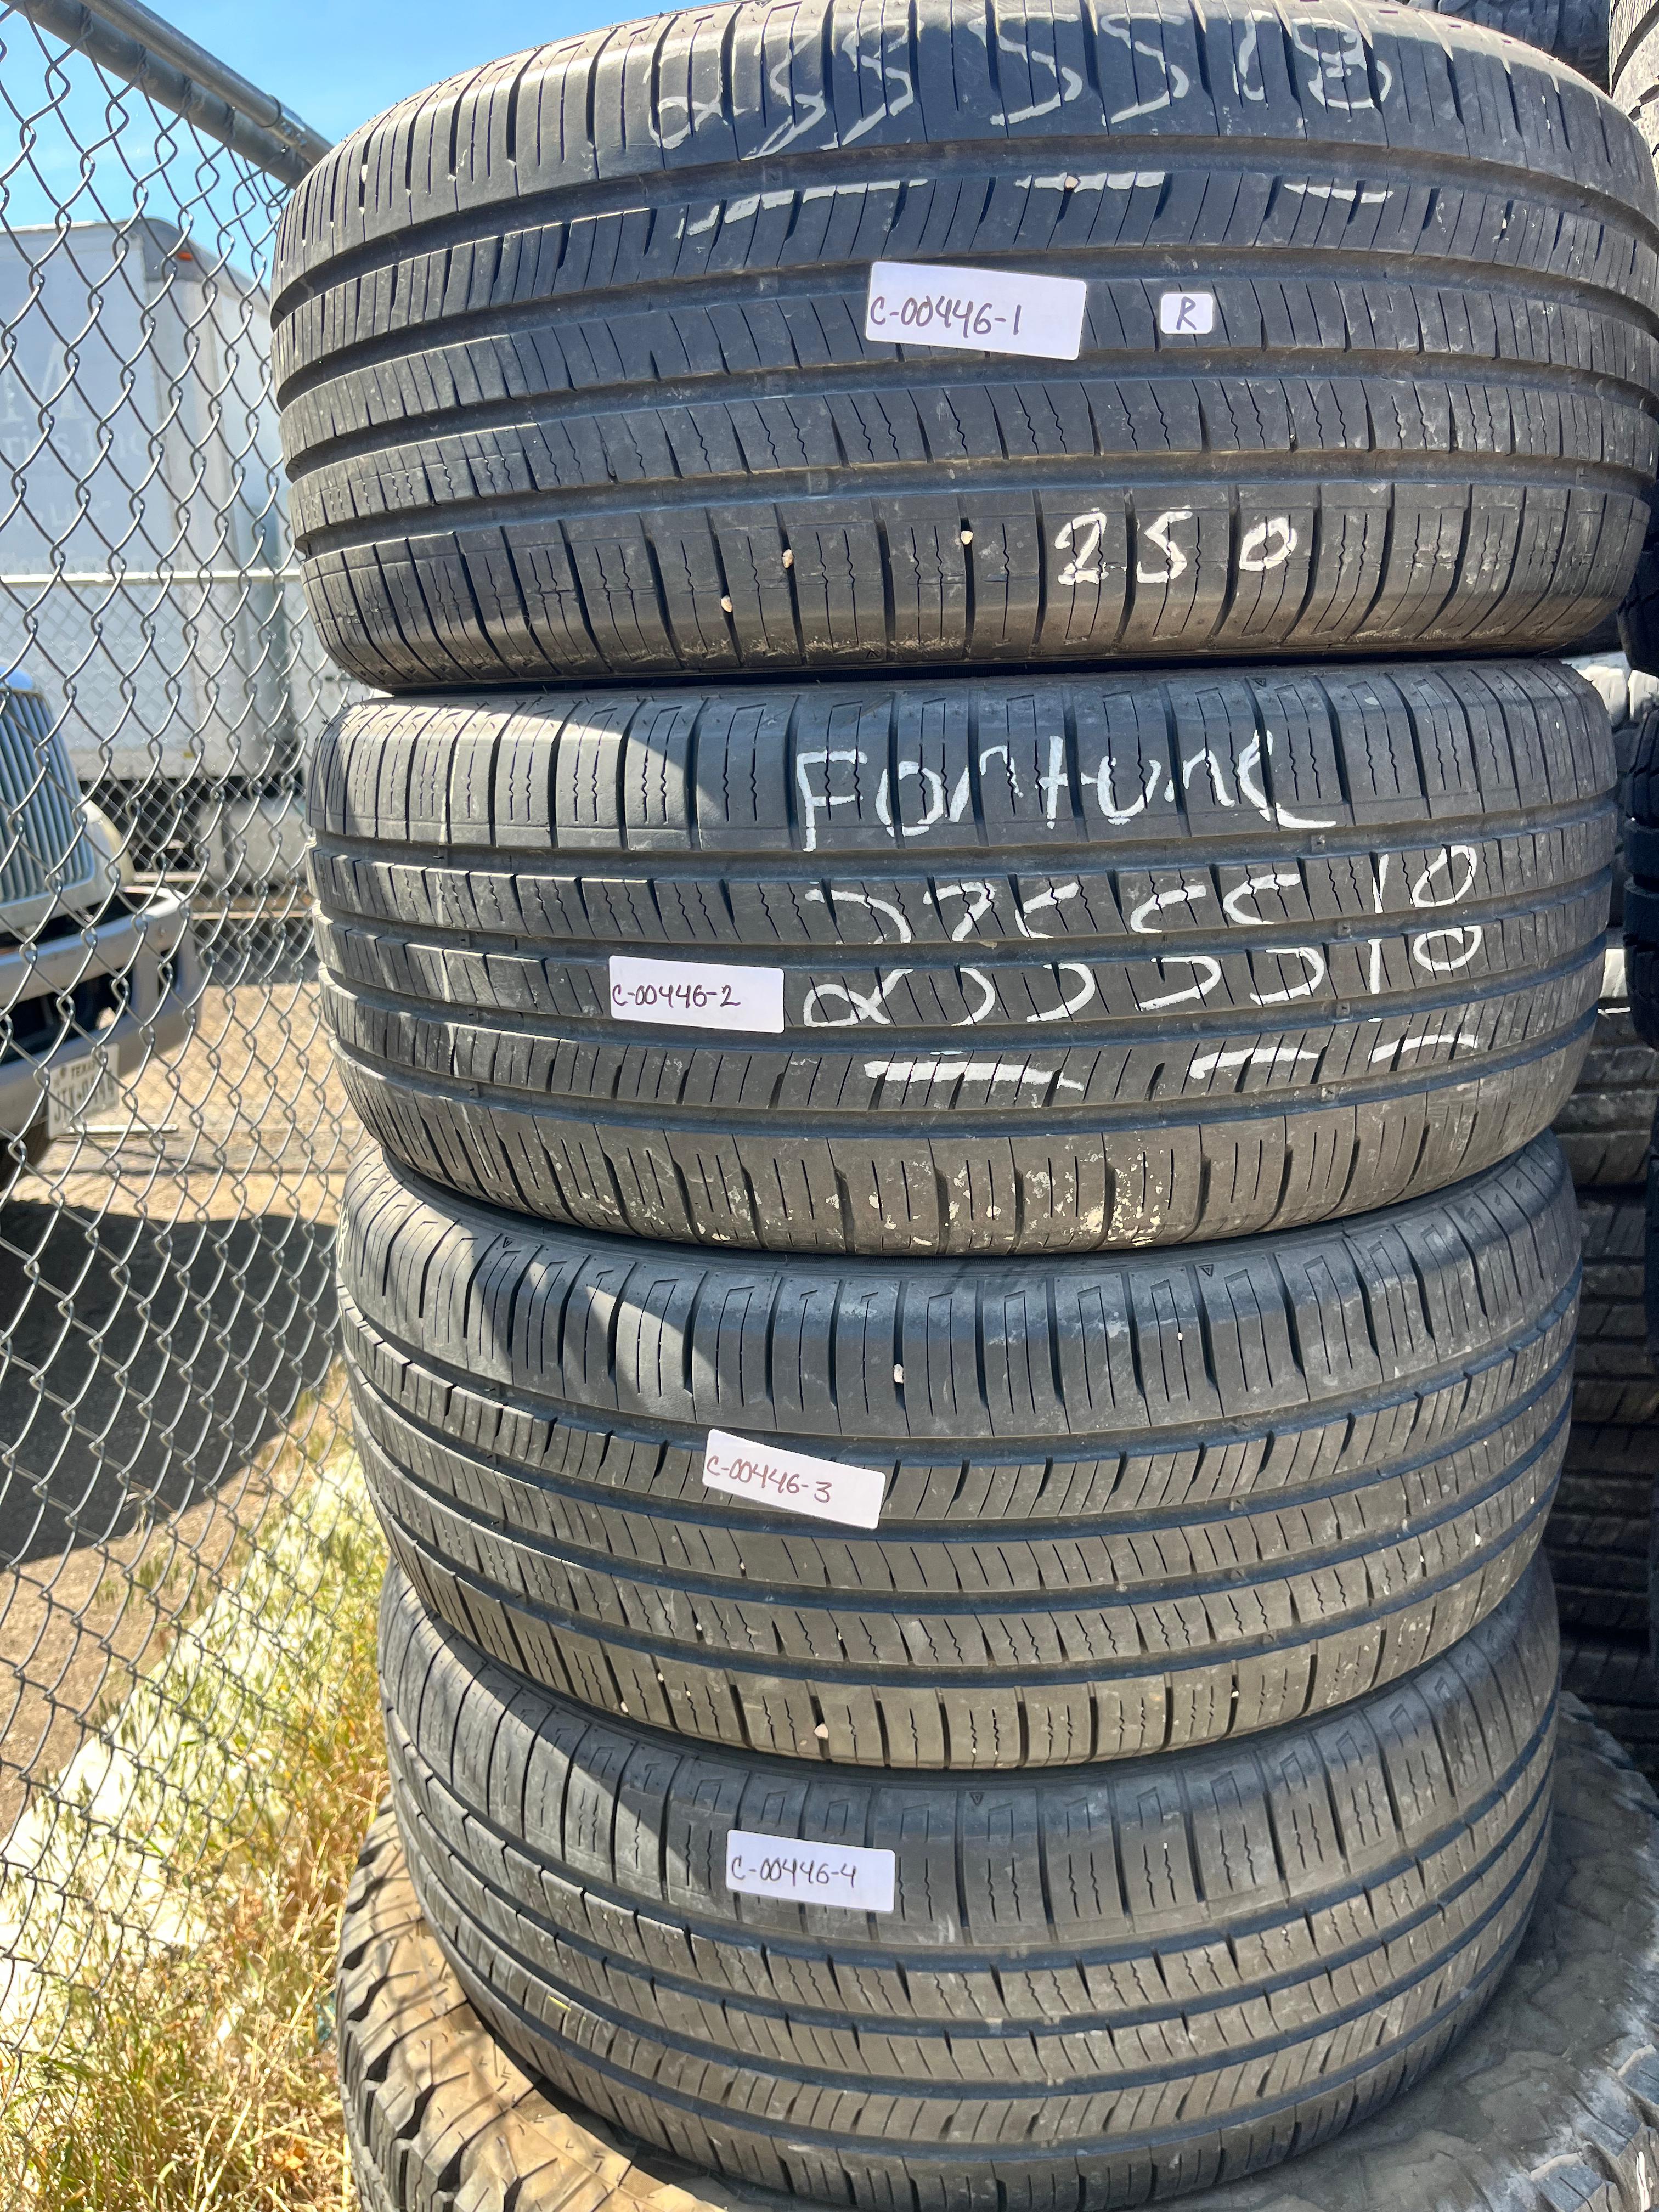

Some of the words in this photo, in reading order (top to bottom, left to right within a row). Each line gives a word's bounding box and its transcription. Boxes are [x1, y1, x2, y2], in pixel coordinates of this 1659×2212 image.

[870, 295, 1022, 339] C-00446-1
[1176, 296, 1197, 330] R
[1054, 507, 1298, 586] 250
[612, 983, 741, 1009] C-00446-2
[706, 1455, 833, 1503] C-00446-3
[731, 1854, 857, 1888] C-00446-4
